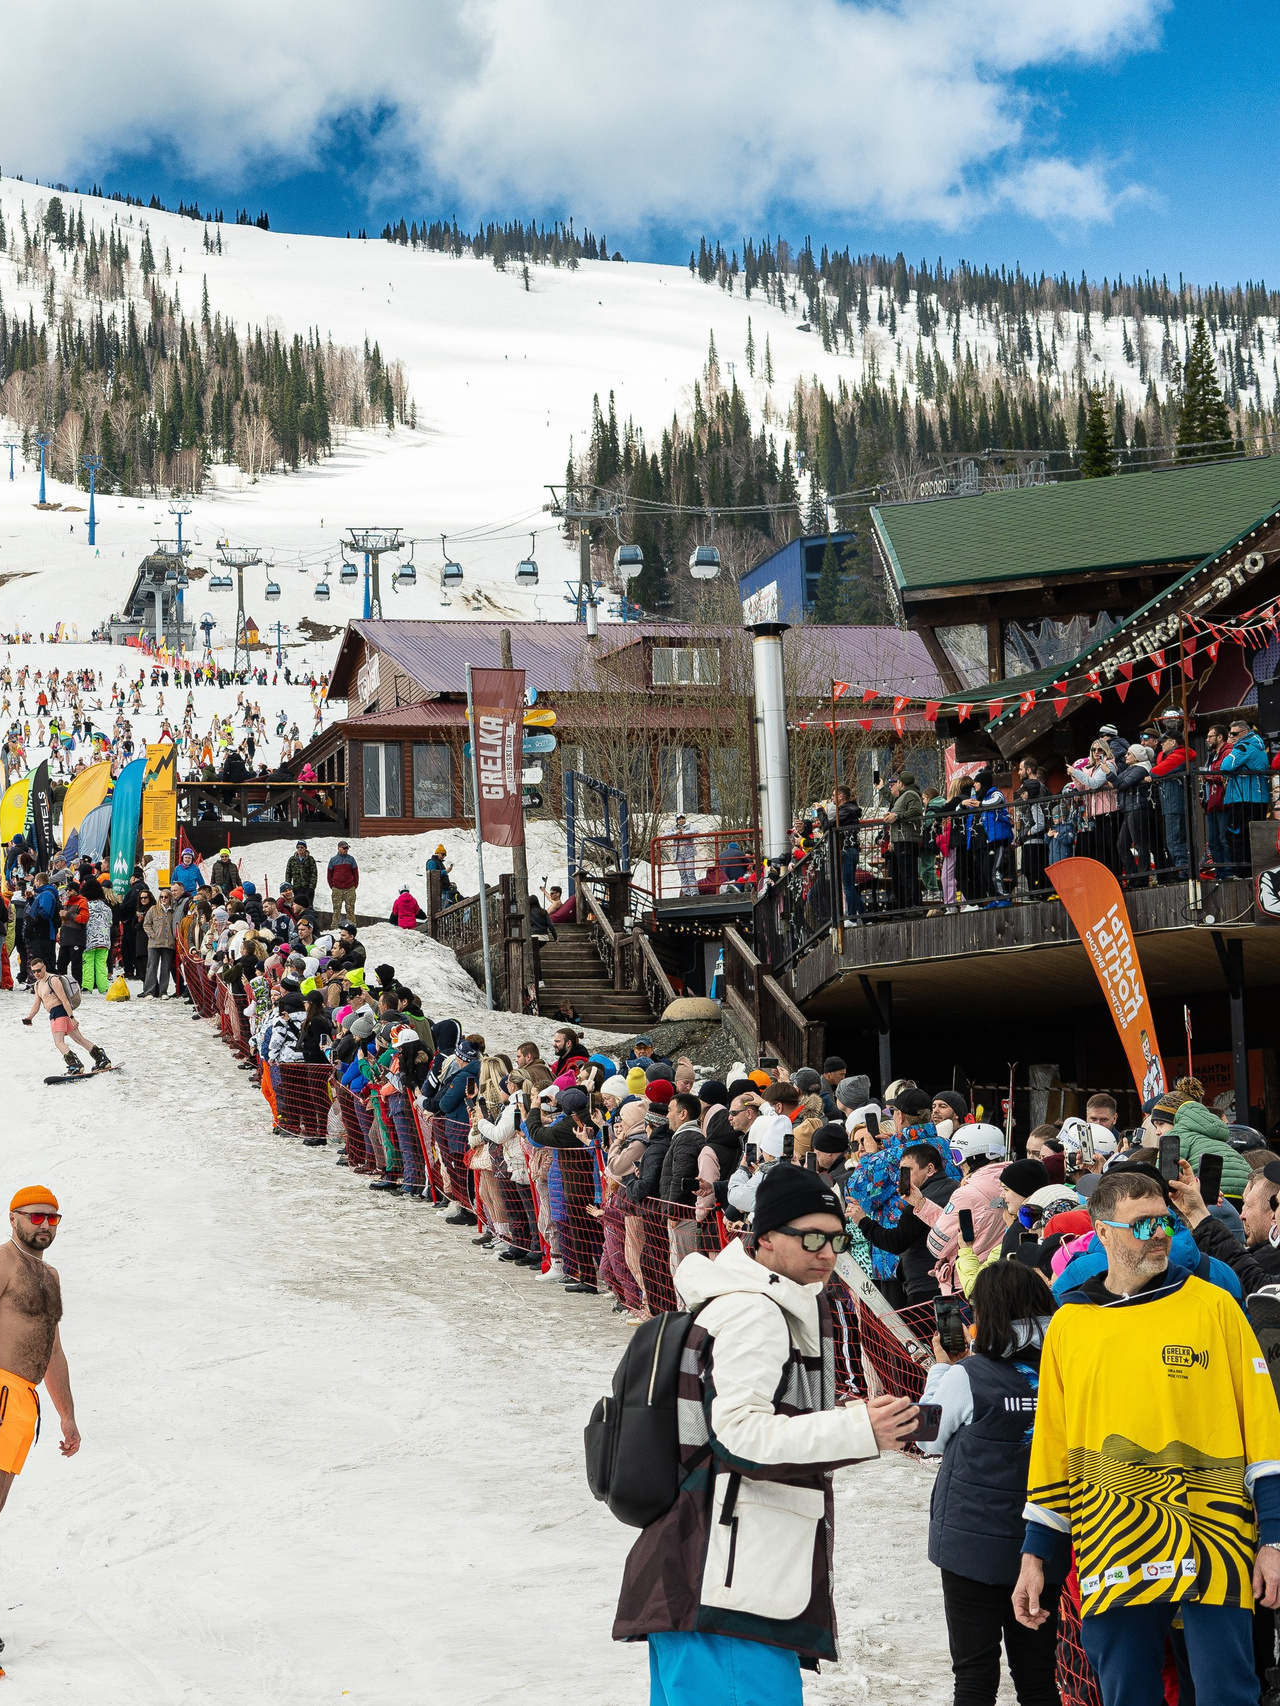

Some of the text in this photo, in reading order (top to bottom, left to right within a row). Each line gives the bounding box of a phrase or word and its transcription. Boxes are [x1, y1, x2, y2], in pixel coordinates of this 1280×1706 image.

[479, 715, 504, 799] GRELKA
[505, 734, 514, 783] APRES SKI BAR
[1166, 1355, 1183, 1363] FEST
